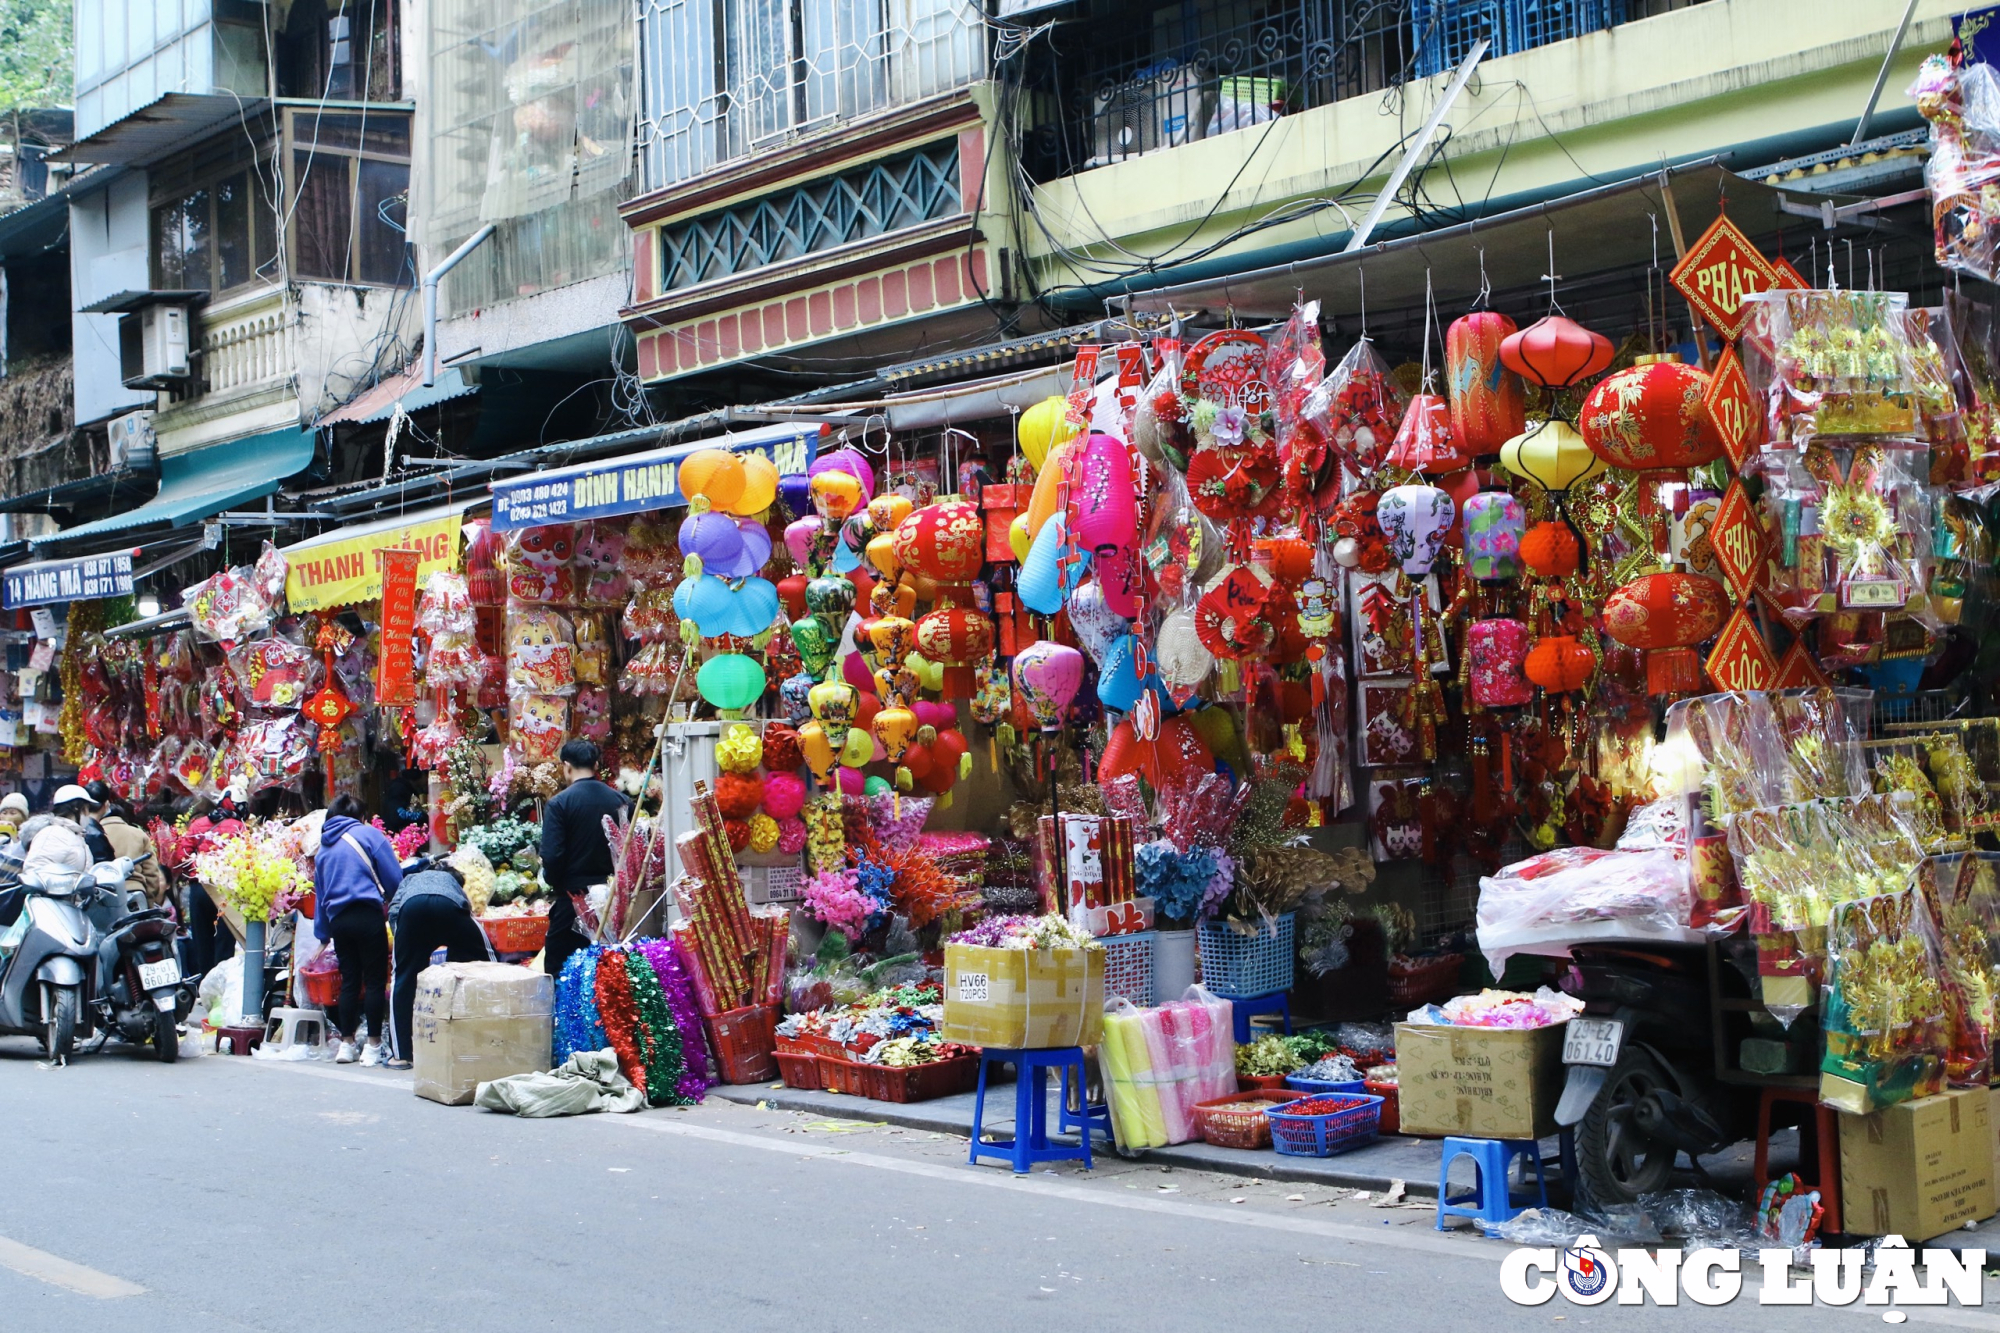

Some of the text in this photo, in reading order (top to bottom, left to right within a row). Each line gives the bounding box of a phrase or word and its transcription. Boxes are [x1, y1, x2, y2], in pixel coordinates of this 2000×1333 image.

[510, 488, 532, 504] 0903
[551, 482, 568, 498] 424
[624, 462, 675, 506] HẠNH
[548, 500, 567, 516] 1423
[1724, 511, 1758, 576] PHÁT
[84, 560, 98, 577] 038
[114, 556, 132, 573] 1958
[296, 552, 365, 587] THANH
[8, 563, 82, 602] 14 HÀNG MÃ
[84, 578, 98, 596] 038
[292, 598, 310, 608] HÀNG
[144, 972, 178, 988] 960.23
[960, 974, 986, 987] HV66
[960, 988, 986, 1000] 720PCS
[1573, 1020, 1614, 1041] 29-E2
[1566, 1041, 1614, 1062] 061.40
